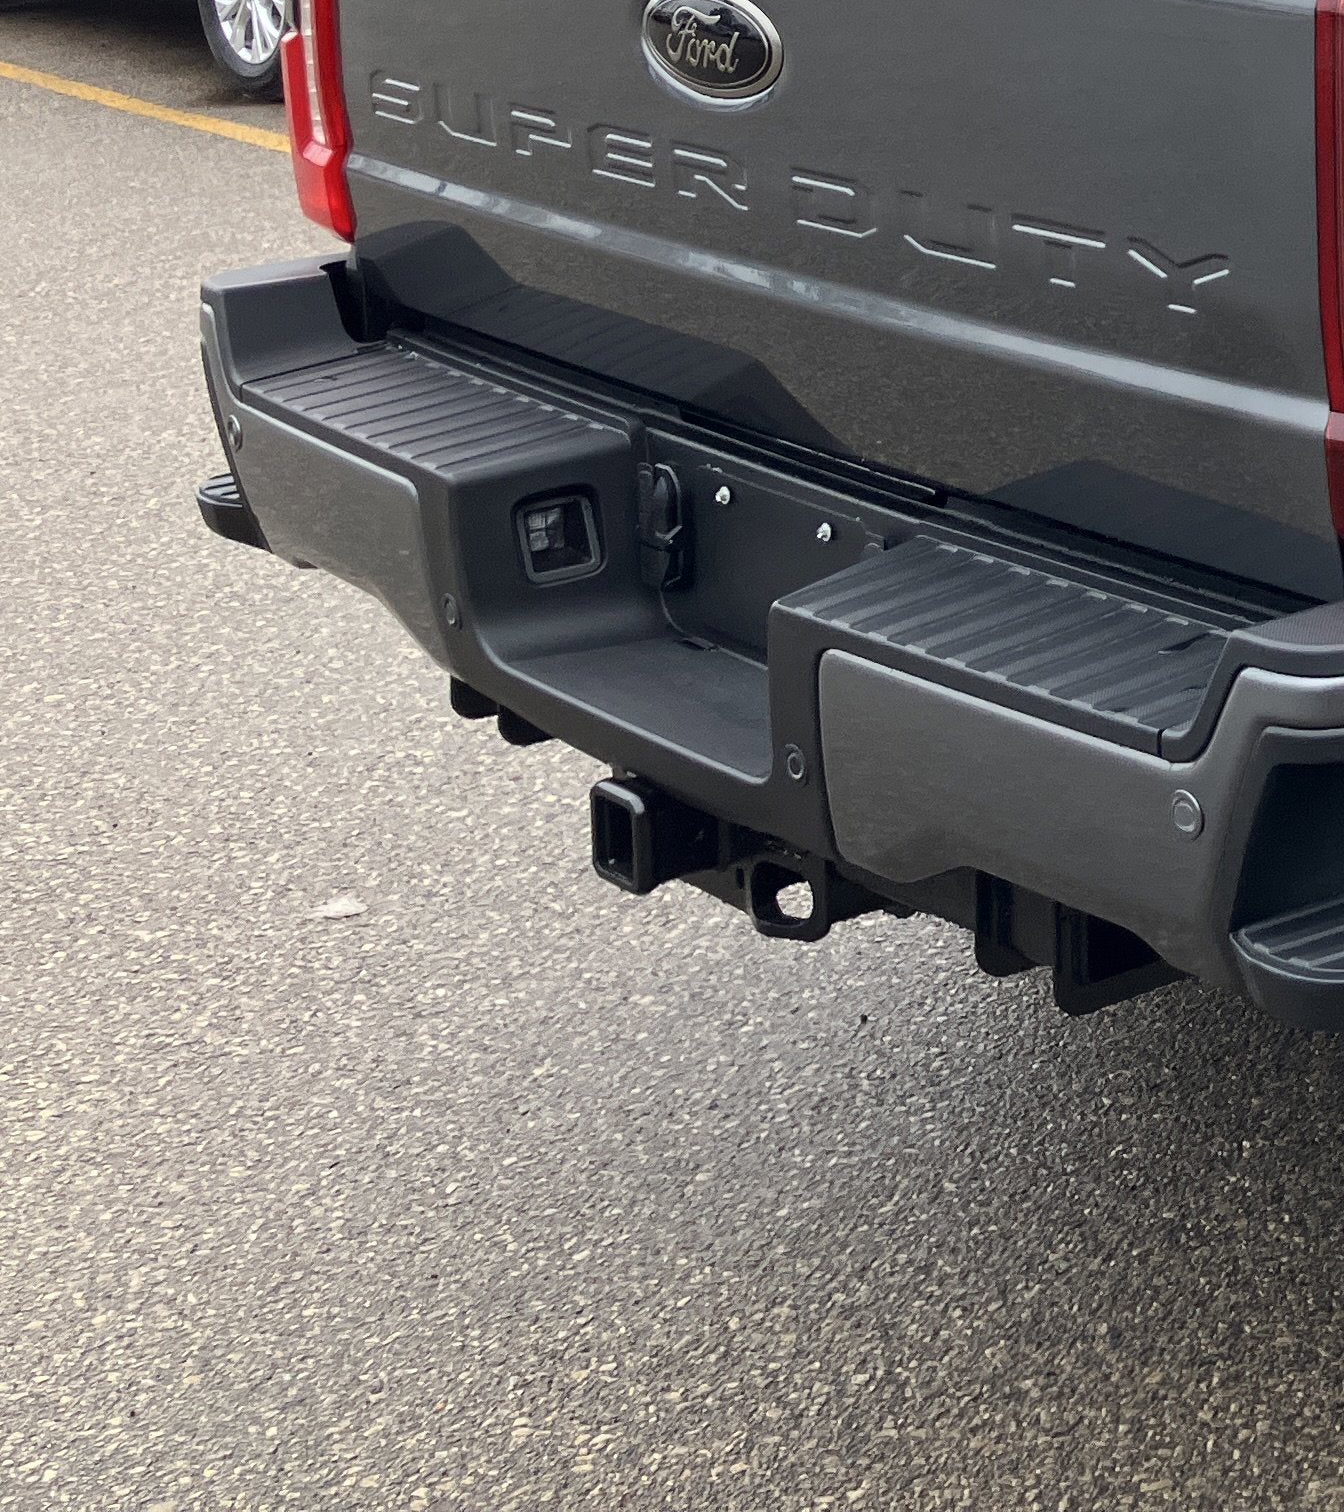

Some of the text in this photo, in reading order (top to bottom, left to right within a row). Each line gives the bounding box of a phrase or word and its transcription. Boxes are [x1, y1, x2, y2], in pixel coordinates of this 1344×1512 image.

[667, 6, 740, 74] Ford
[370, 69, 1230, 313] SUPER DUTY
